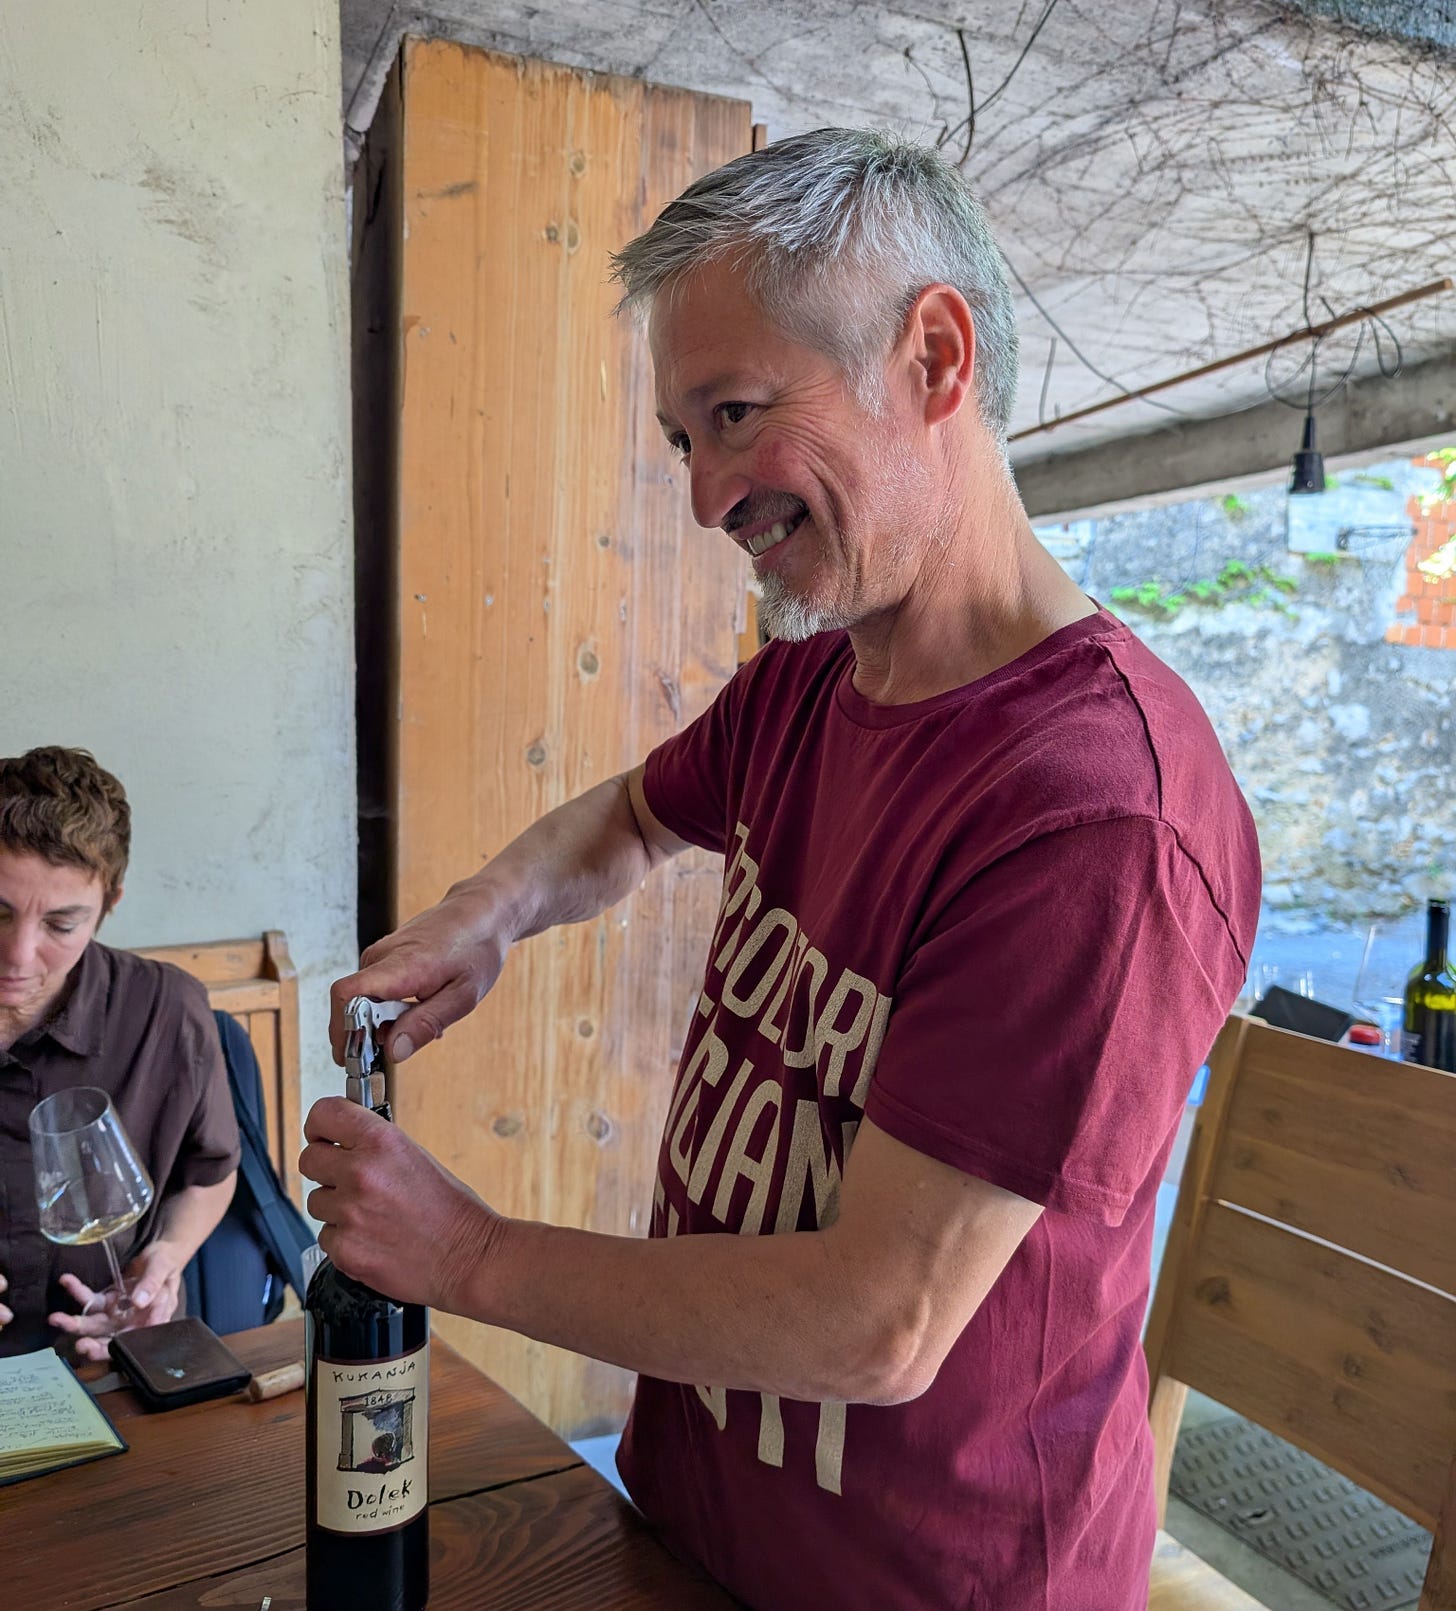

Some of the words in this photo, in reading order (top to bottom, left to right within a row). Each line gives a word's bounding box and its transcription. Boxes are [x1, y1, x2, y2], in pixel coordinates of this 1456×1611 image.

[332, 1360, 416, 1383] KUKANJA
[355, 1507, 379, 1520] red
[382, 1504, 405, 1516] wine
